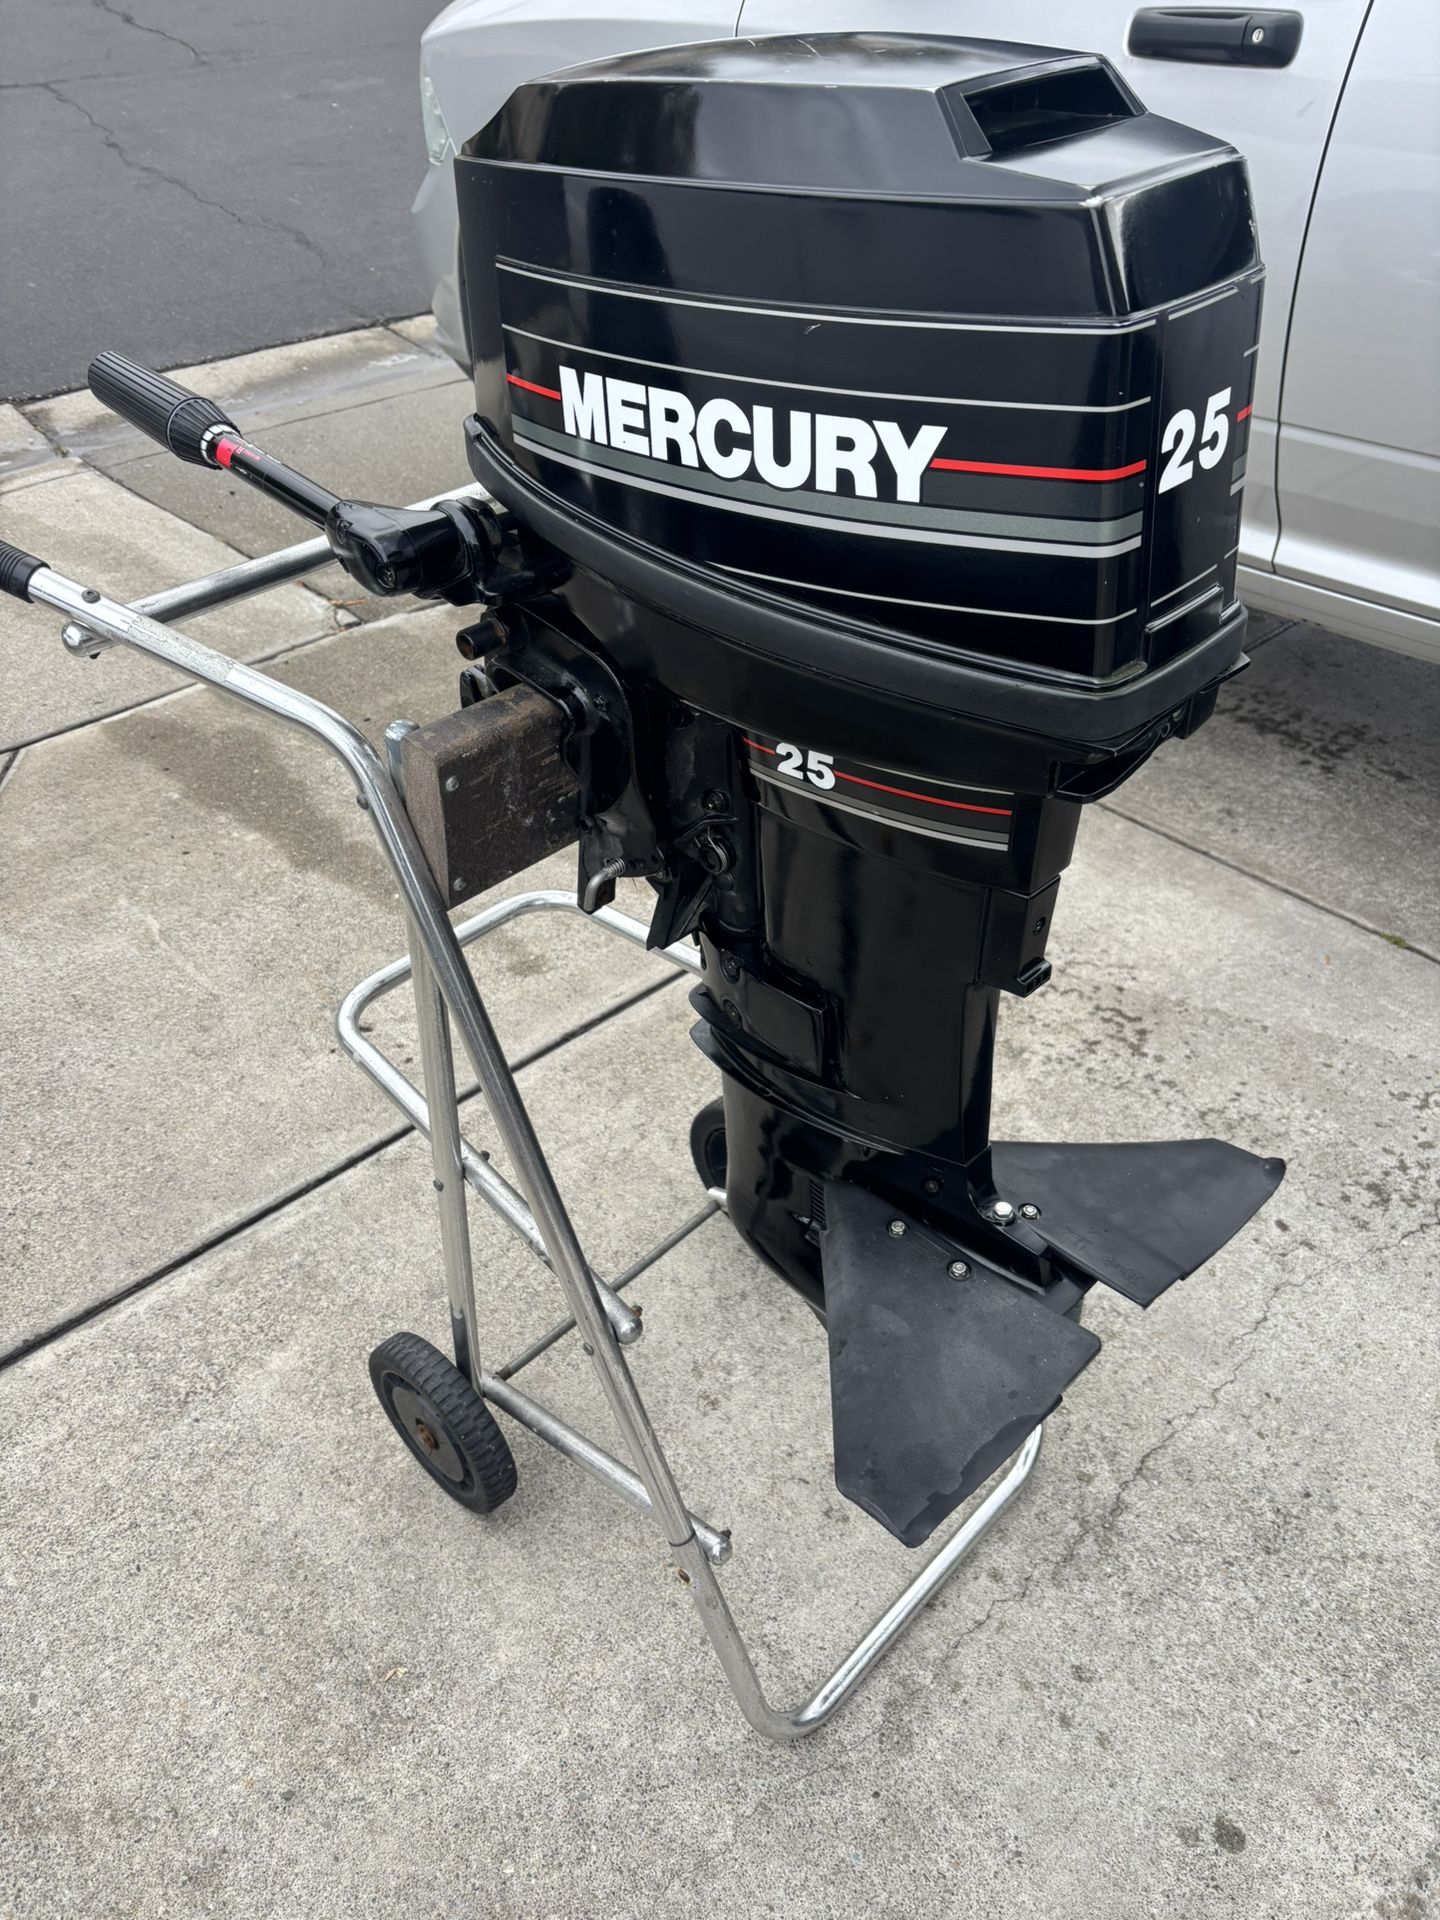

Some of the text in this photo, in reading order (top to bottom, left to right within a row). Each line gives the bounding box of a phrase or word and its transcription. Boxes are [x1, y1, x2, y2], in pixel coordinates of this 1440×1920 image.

[559, 366, 948, 503] MERCURY
[1158, 387, 1232, 494] 25
[775, 743, 836, 790] 25
